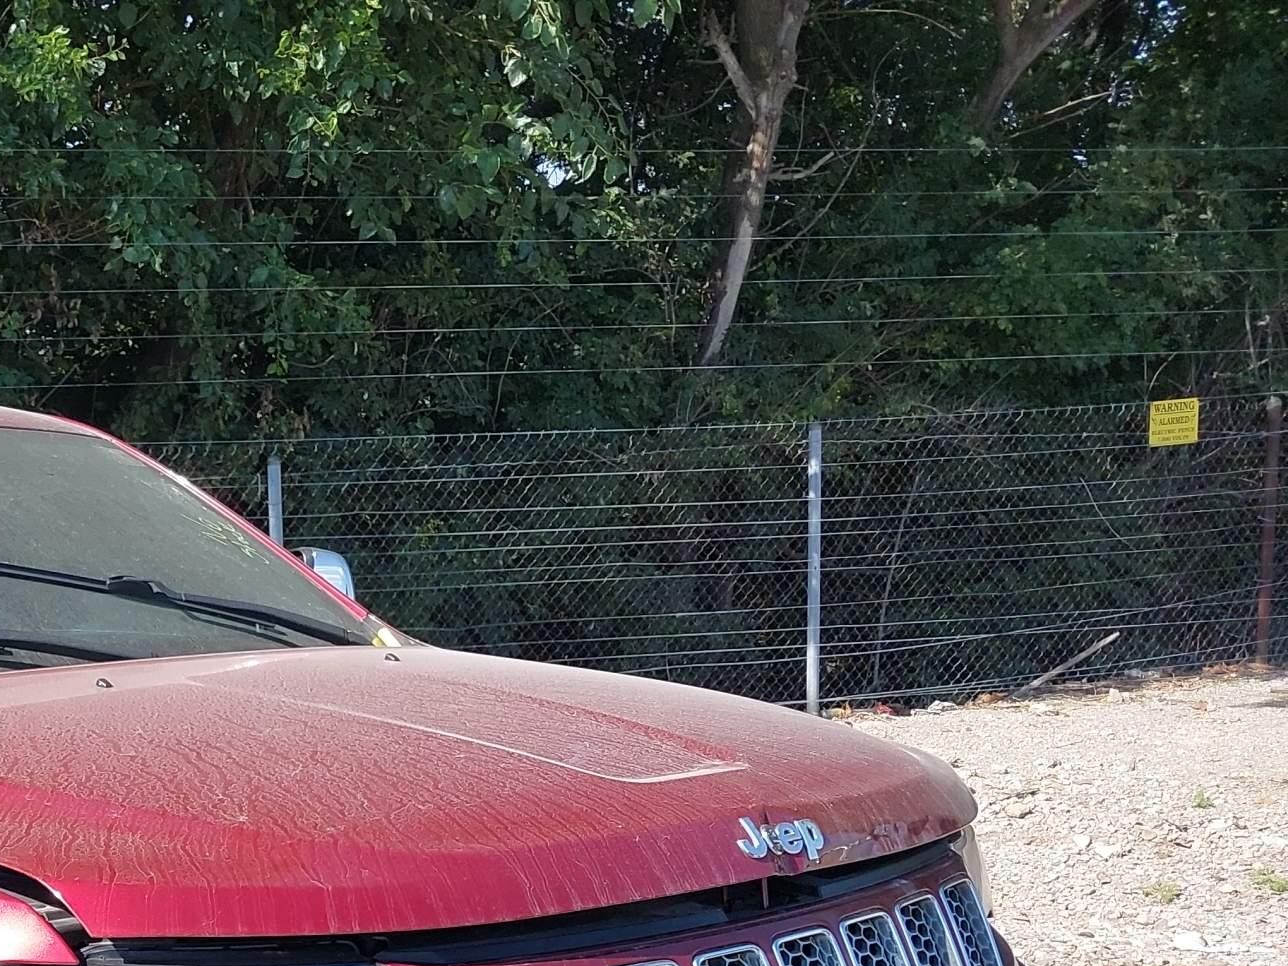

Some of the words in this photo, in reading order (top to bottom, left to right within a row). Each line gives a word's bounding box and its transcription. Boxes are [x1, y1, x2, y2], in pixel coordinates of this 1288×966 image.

[1154, 401, 1196, 413] WARNING
[1159, 415, 1190, 426] ALARMED
[736, 816, 824, 862] Jeep
